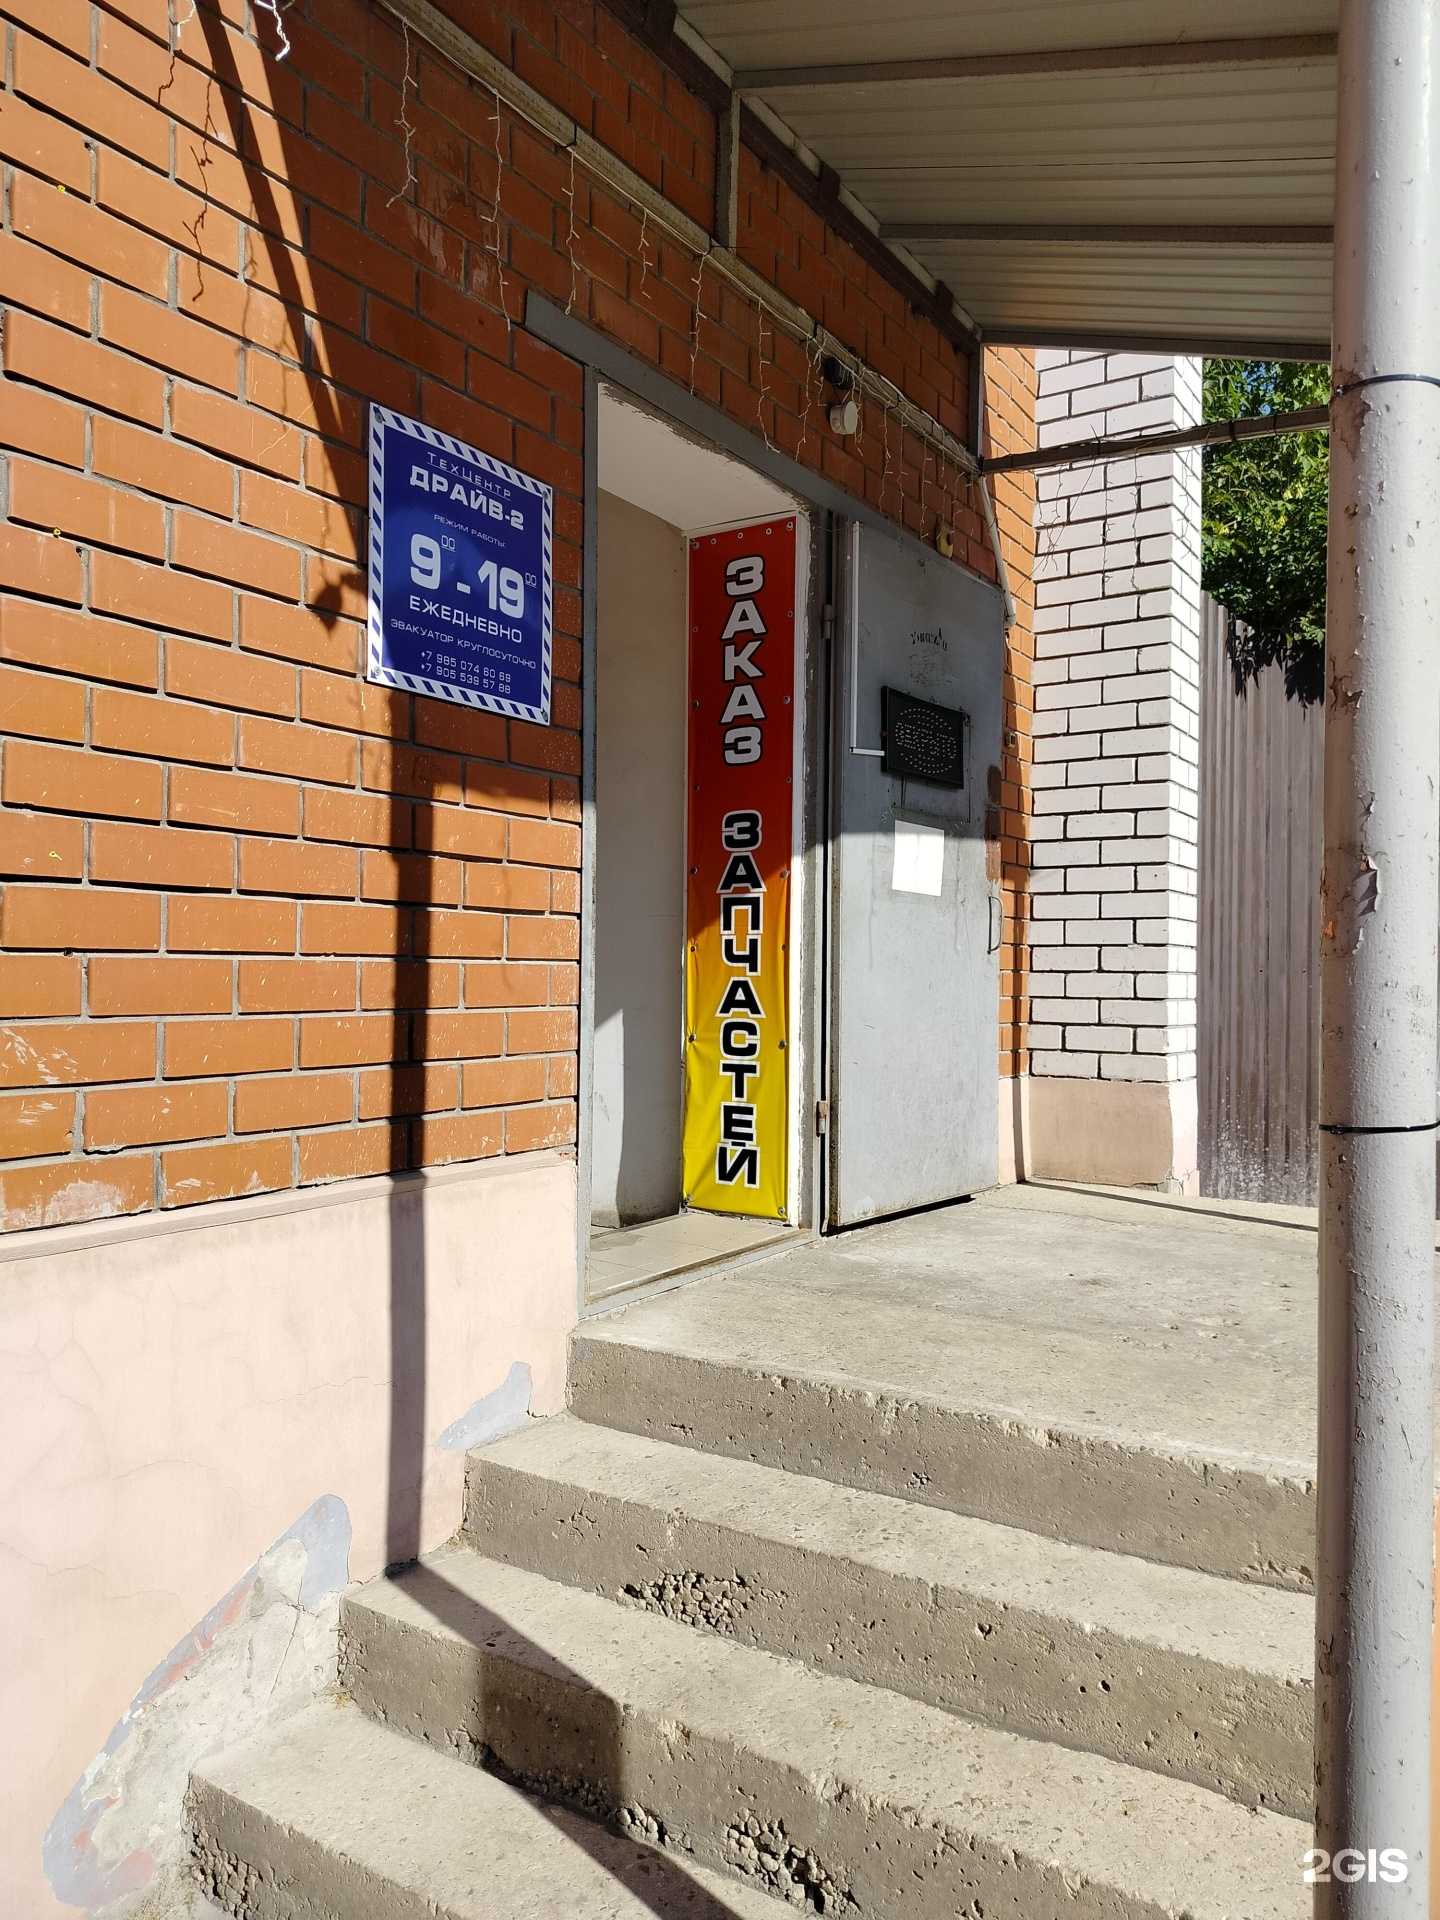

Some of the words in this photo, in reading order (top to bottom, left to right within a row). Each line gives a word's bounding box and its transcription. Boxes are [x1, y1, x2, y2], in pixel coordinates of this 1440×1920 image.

[409, 464, 524, 531] ДРАЙВ-2
[433, 513, 469, 533] РЕЖИМ
[410, 533, 441, 590] 9
[477, 559, 525, 619] 19
[390, 618, 455, 644] ЭВАКУАТОР
[457, 638, 537, 670] КРУГЛОСУТОЧНО
[409, 594, 522, 644] ЕЖЕДНЕВНО
[420, 662, 433, 673] +7
[436, 665, 457, 680] 905
[460, 672, 480, 686] 539
[482, 678, 496, 690] 57
[421, 650, 433, 661] +7
[436, 653, 457, 667] 985
[460, 660, 480, 674] 074
[483, 666, 496, 678] 60
[720, 553, 767, 766] ЗАКАЗ
[714, 808, 768, 1189] ЗАПЧАСТЕЙ
